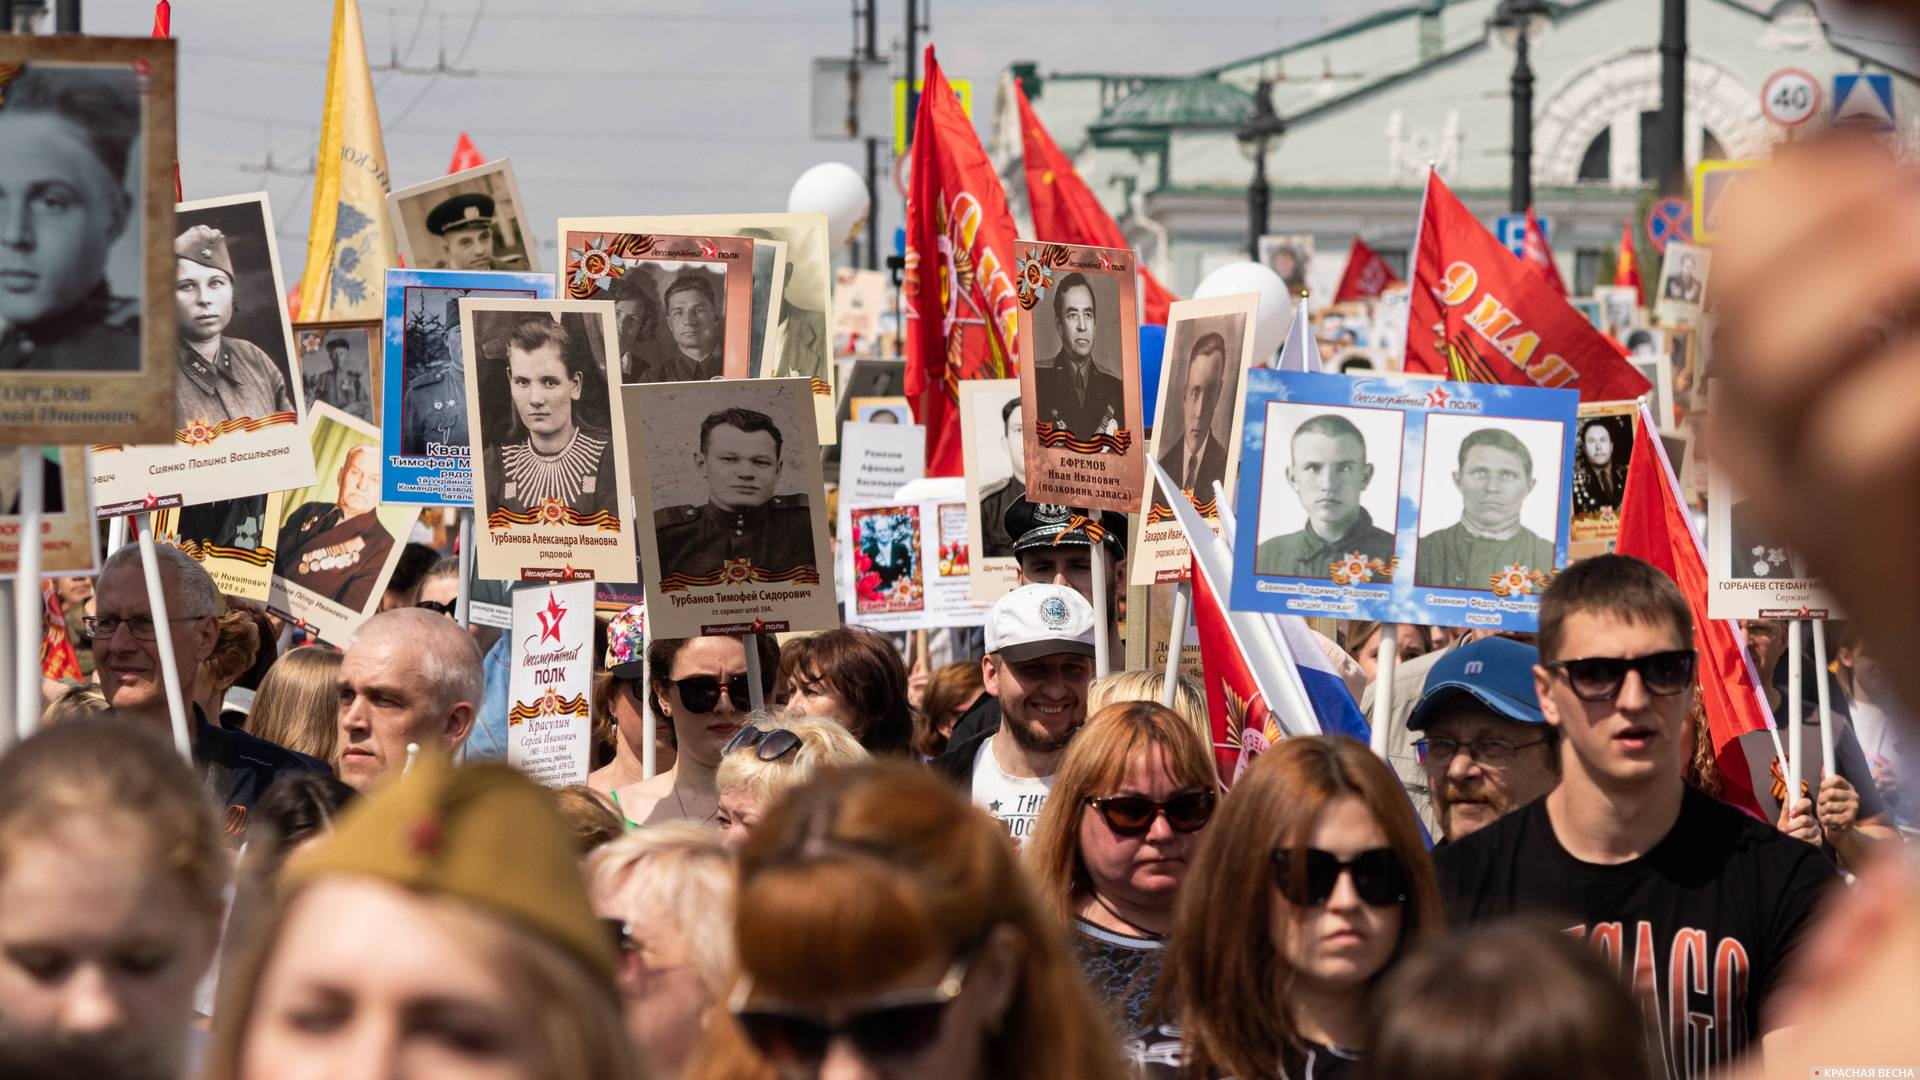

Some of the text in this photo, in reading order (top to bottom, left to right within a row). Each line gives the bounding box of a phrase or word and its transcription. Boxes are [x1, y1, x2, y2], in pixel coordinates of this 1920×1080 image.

[1773, 86, 1808, 109] 40
[1430, 261, 1580, 389] 9 МАЯ
[149, 445, 290, 476] Сиянко Полина Васильевна
[390, 456, 454, 470] Тимофей
[1060, 457, 1106, 471] ЕФРЕМОВ
[1048, 470, 1120, 486] Иван Иванович
[1038, 481, 1132, 502] (полковник запаса)
[490, 532, 618, 548] Турбанова Александра Ивановна
[1144, 530, 1167, 544] Захаров
[1168, 528, 1183, 540] Иван
[540, 550, 573, 560] рядовой
[221, 573, 267, 588] Никитович
[1719, 582, 1766, 591] ГОРБАЧЕВ
[1768, 582, 1807, 591] СТЕФАН
[670, 589, 811, 607] Турбанов Тимофей Сидорович
[1776, 593, 1810, 602] Сержант
[720, 607, 744, 616] сержант
[745, 606, 759, 615] штаб
[522, 635, 583, 668] бессмертный
[534, 667, 566, 685] ПОЛК
[528, 718, 570, 734] Красулин
[520, 732, 577, 748] Сергей Иванович
